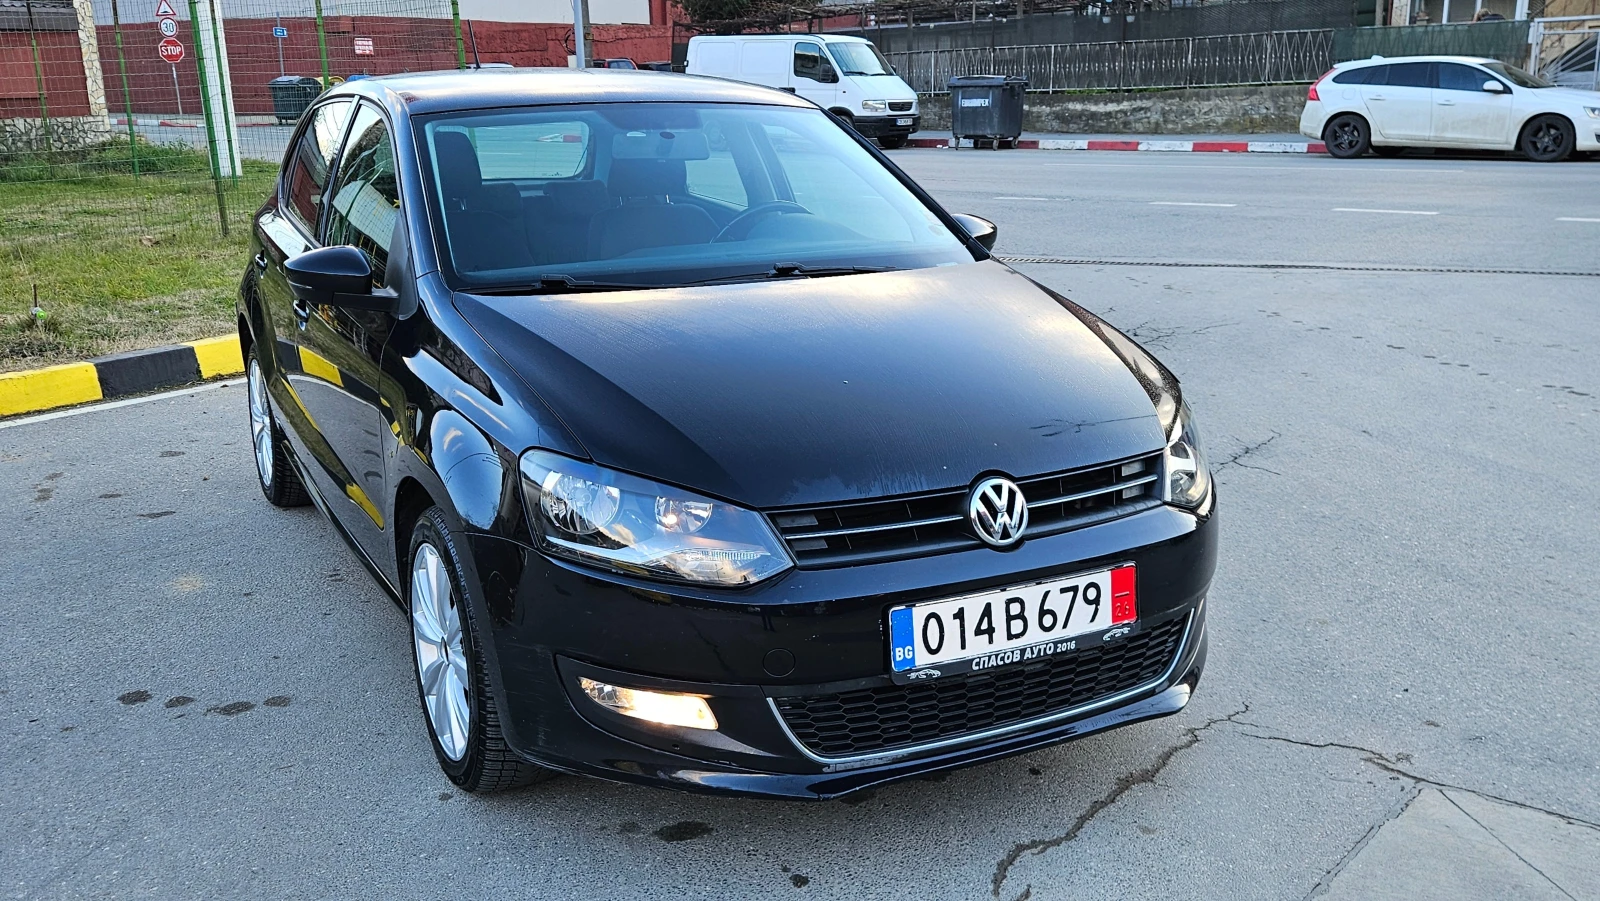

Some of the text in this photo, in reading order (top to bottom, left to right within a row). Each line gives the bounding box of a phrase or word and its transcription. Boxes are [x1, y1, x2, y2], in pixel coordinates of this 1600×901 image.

[163, 22, 174, 32] 30
[161, 46, 181, 55] STOP
[895, 646, 913, 662] BG
[971, 640, 1076, 671] СПАСОВ АУТО 2016
